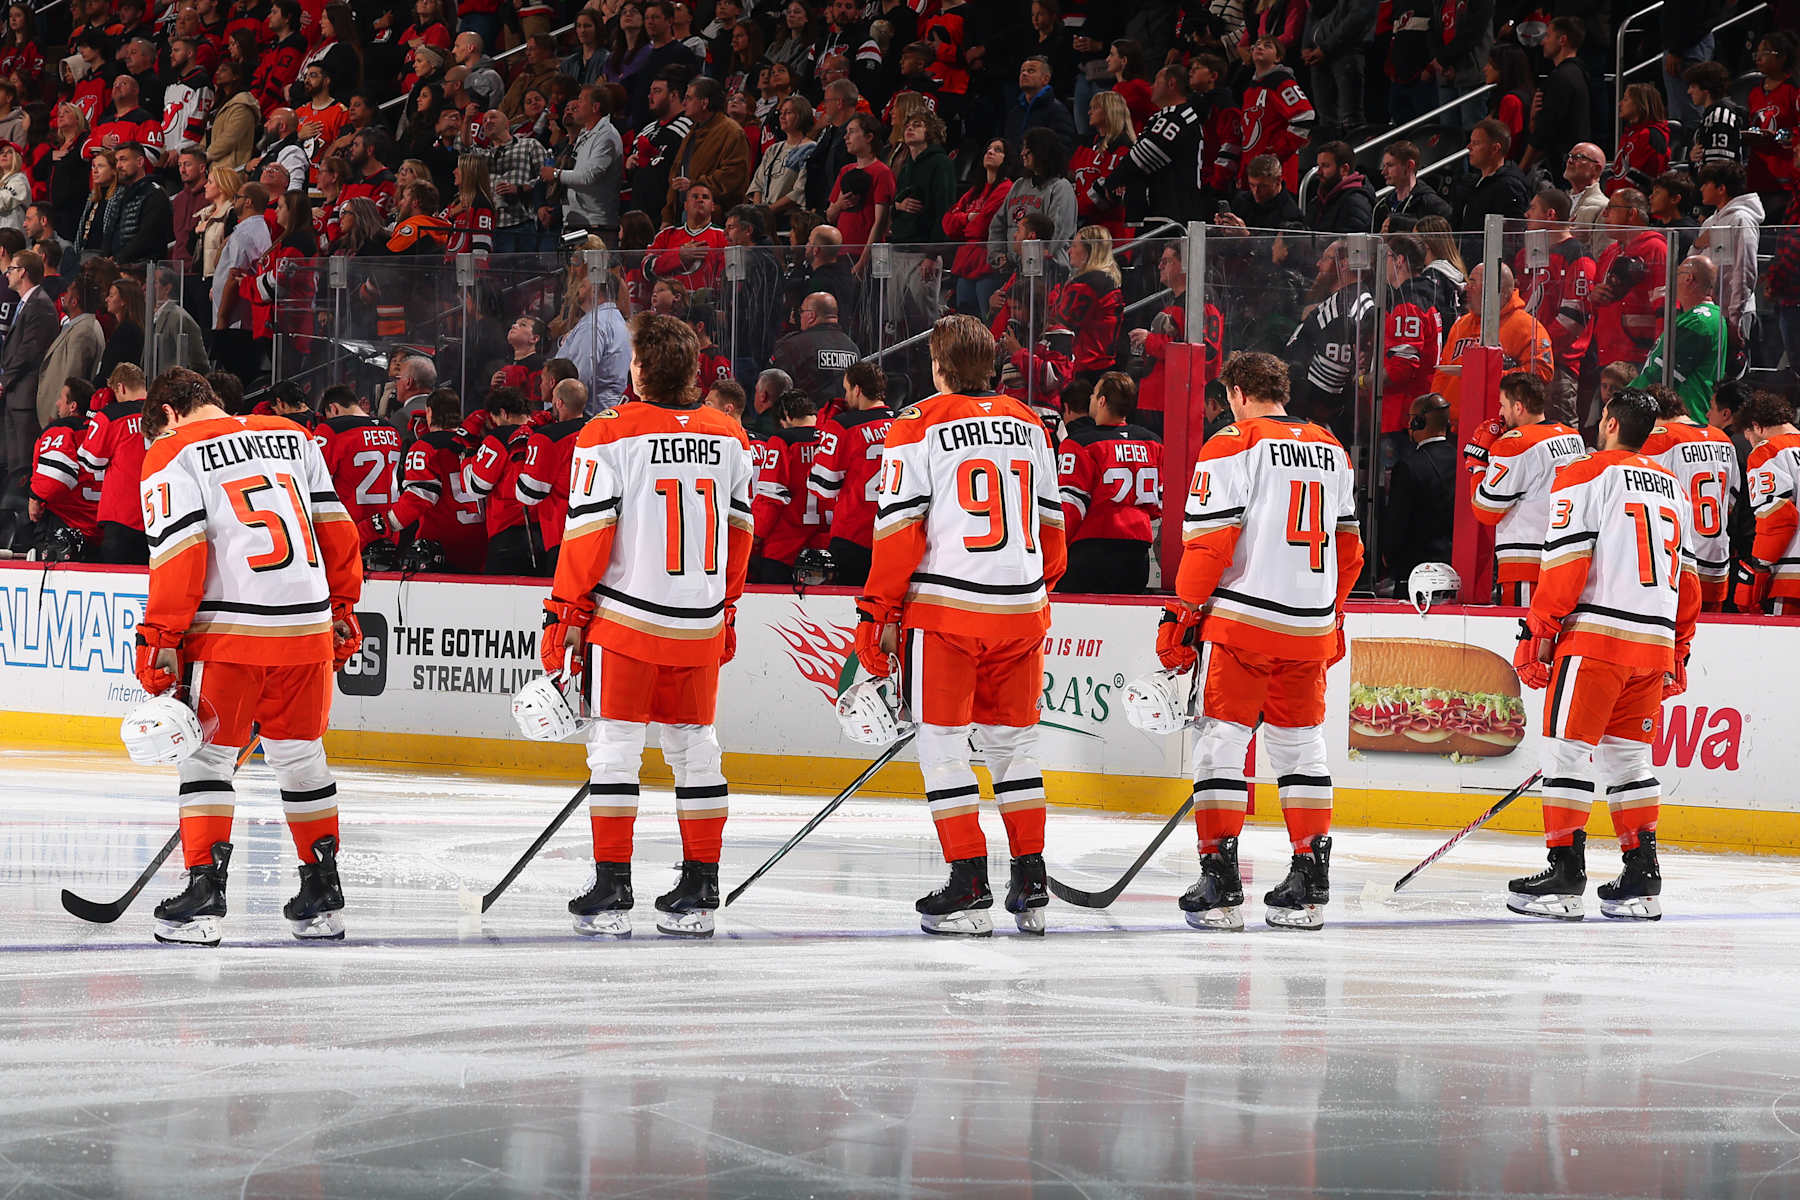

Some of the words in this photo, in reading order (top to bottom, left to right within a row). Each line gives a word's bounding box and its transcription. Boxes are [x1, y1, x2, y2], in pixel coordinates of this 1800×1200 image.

[1256, 89, 1267, 107] A
[1281, 84, 1307, 106] 86
[147, 131, 163, 145] 44
[1151, 117, 1180, 142] 86
[1711, 133, 1728, 148] 13
[1395, 316, 1420, 338] 13
[820, 351, 857, 368] SECURITY
[1326, 342, 1351, 363] 86
[40, 434, 64, 452] 34
[363, 430, 399, 446] PESCE
[938, 421, 1033, 451] CARLSSON
[196, 435, 302, 472] ZELLWEGER
[476, 443, 498, 469] 47
[525, 445, 538, 466] 11
[648, 438, 721, 465] ZEGRAS
[1115, 443, 1149, 462] MEIER
[1269, 443, 1335, 472] FOWLER
[571, 457, 598, 496] 11
[1489, 462, 1509, 488] 7
[1190, 471, 1211, 506] 4
[143, 482, 171, 528] 51
[956, 458, 1037, 554] 91
[221, 472, 319, 573] 51
[655, 478, 719, 576] 11
[1287, 480, 1329, 573] 4
[1625, 502, 1682, 593] 13
[393, 627, 434, 656] THE
[441, 629, 536, 660] GOTHAM
[1057, 638, 1072, 656] IS
[1076, 639, 1103, 657] HOT
[413, 665, 494, 693] STREAM
